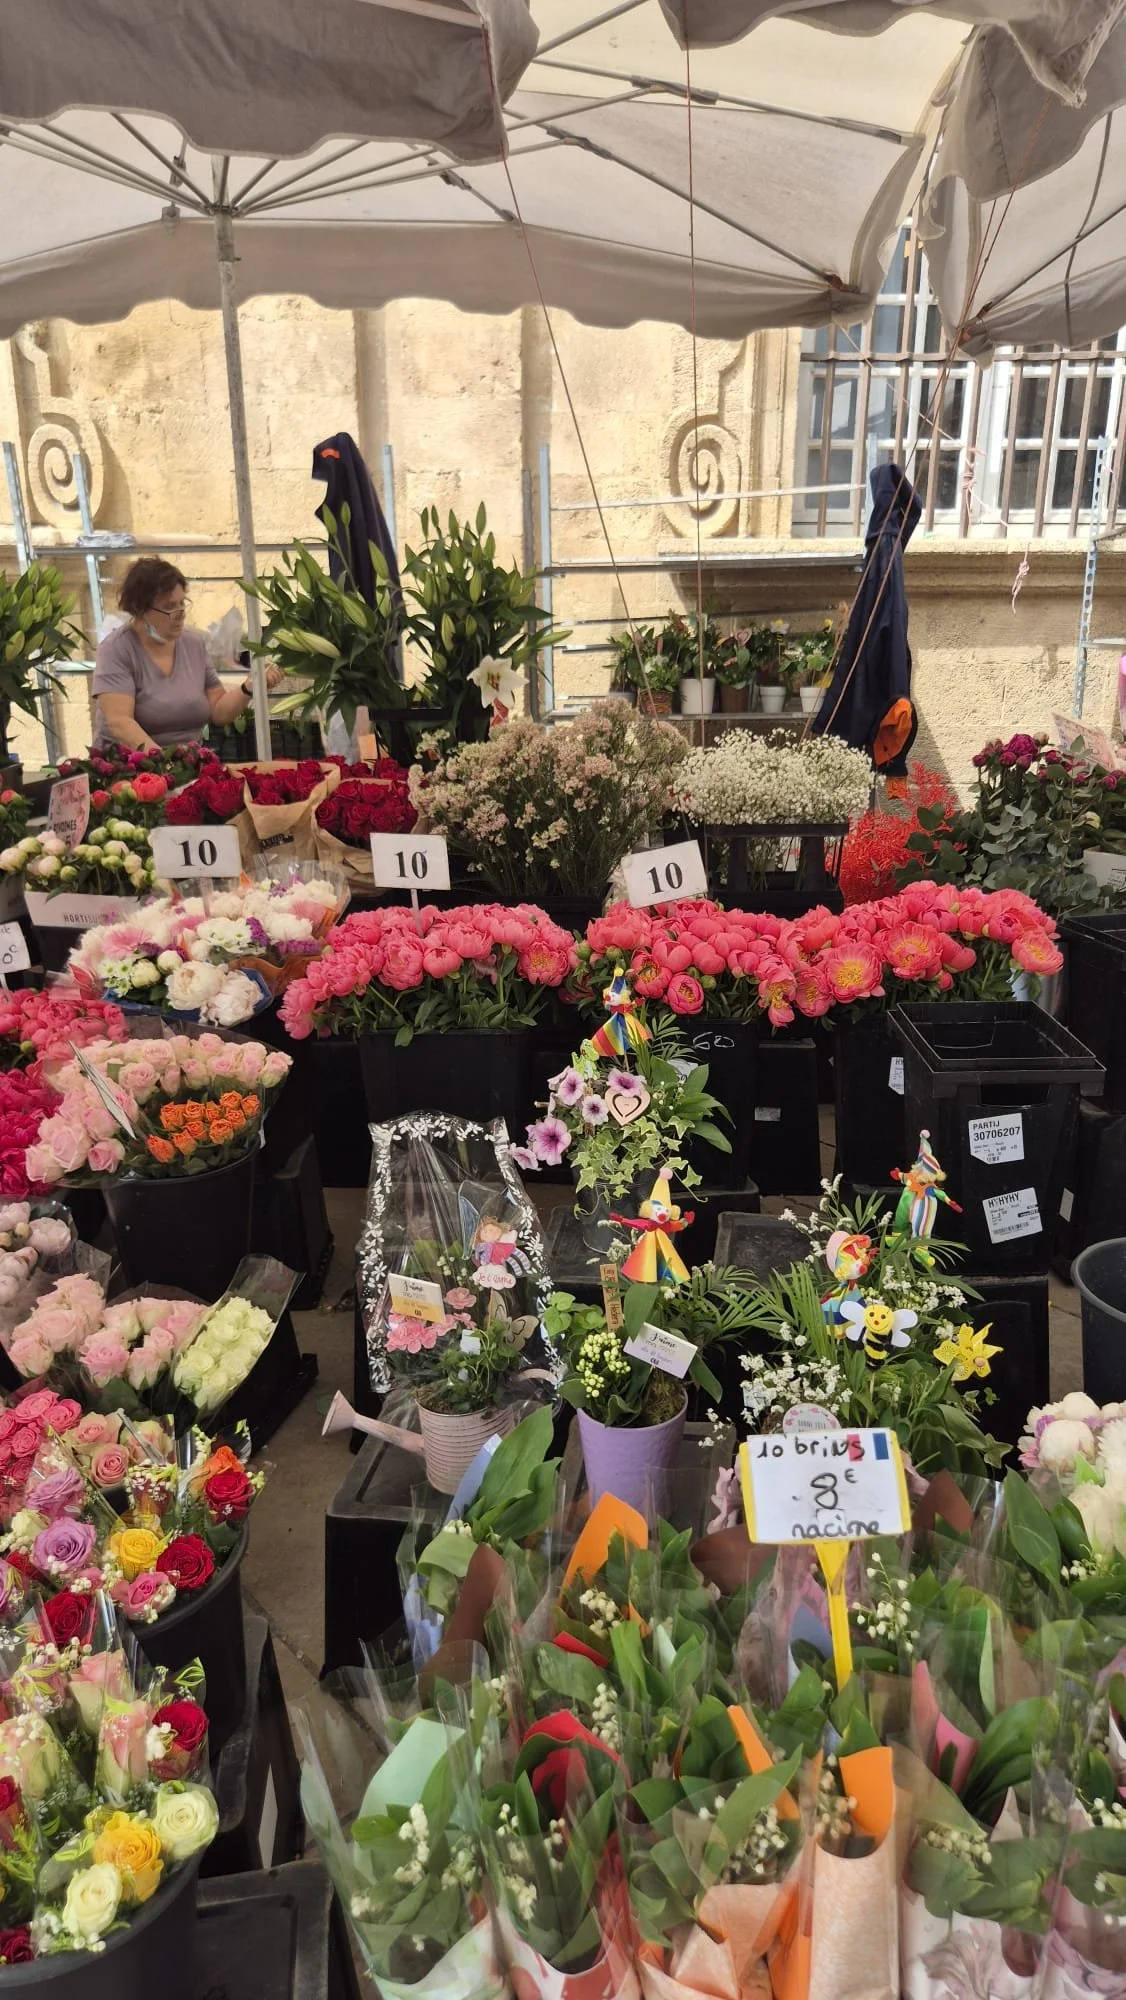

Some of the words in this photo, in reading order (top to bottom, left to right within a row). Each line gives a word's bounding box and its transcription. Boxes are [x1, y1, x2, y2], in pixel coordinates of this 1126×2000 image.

[178, 839, 217, 866] 10
[393, 851, 428, 879] 10
[646, 862, 683, 894] 10
[973, 1120, 1000, 1130] PARTIJ
[973, 1126, 1021, 1141] 30706207
